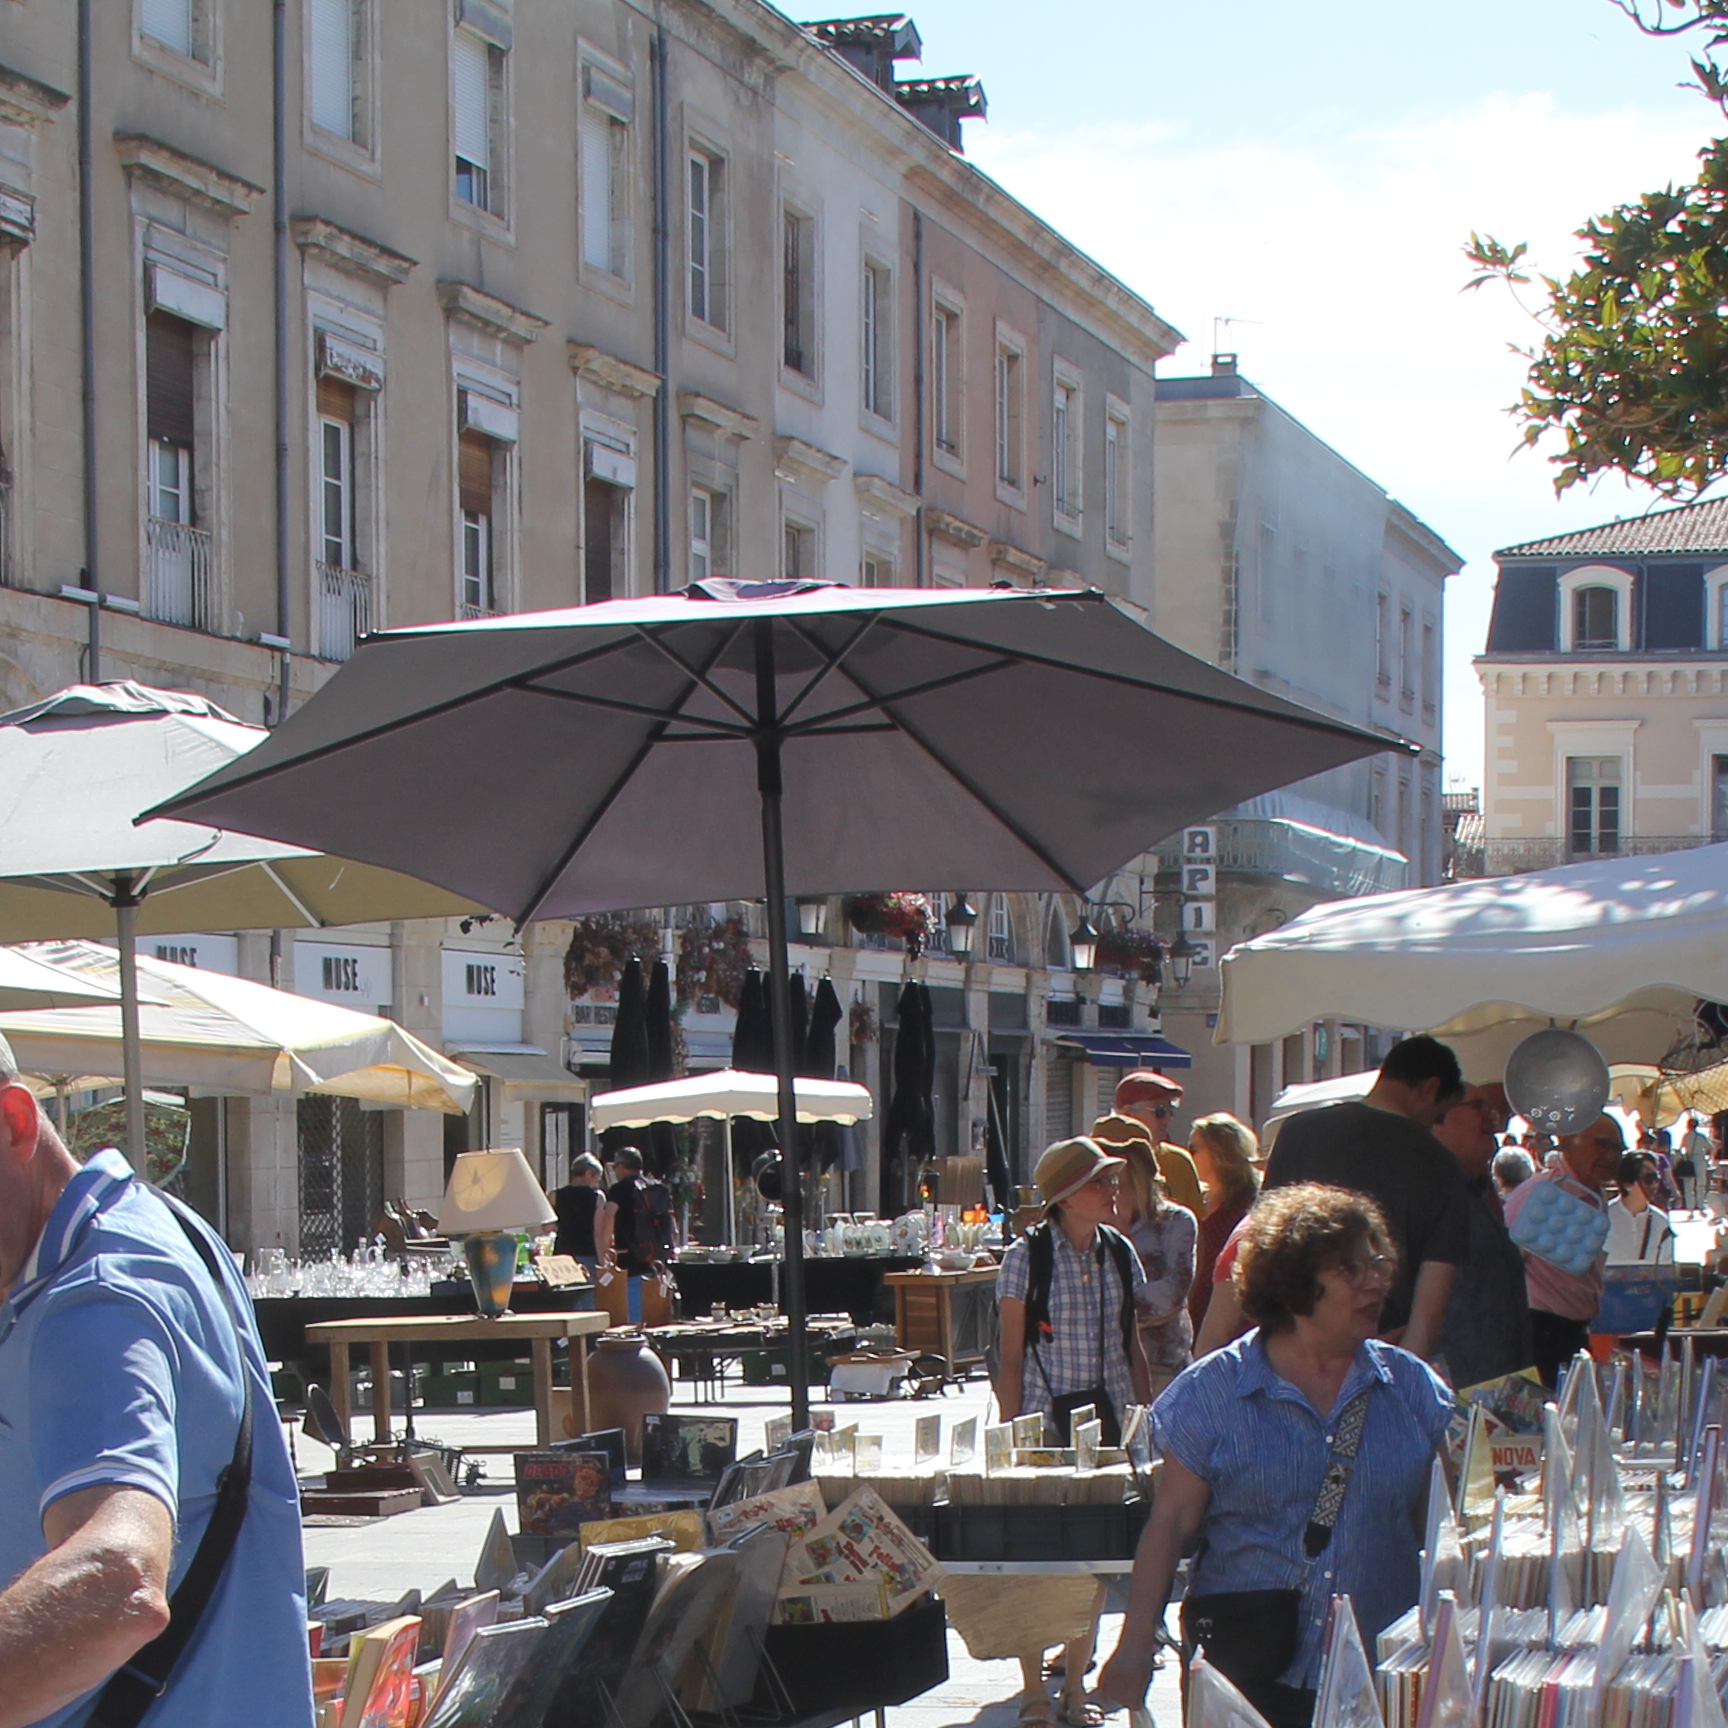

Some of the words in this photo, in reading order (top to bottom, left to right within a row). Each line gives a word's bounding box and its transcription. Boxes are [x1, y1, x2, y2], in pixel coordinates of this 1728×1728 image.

[323, 956, 359, 991] MUSE
[466, 963, 497, 997] MUSE
[1492, 1446, 1536, 1467] NOVA
